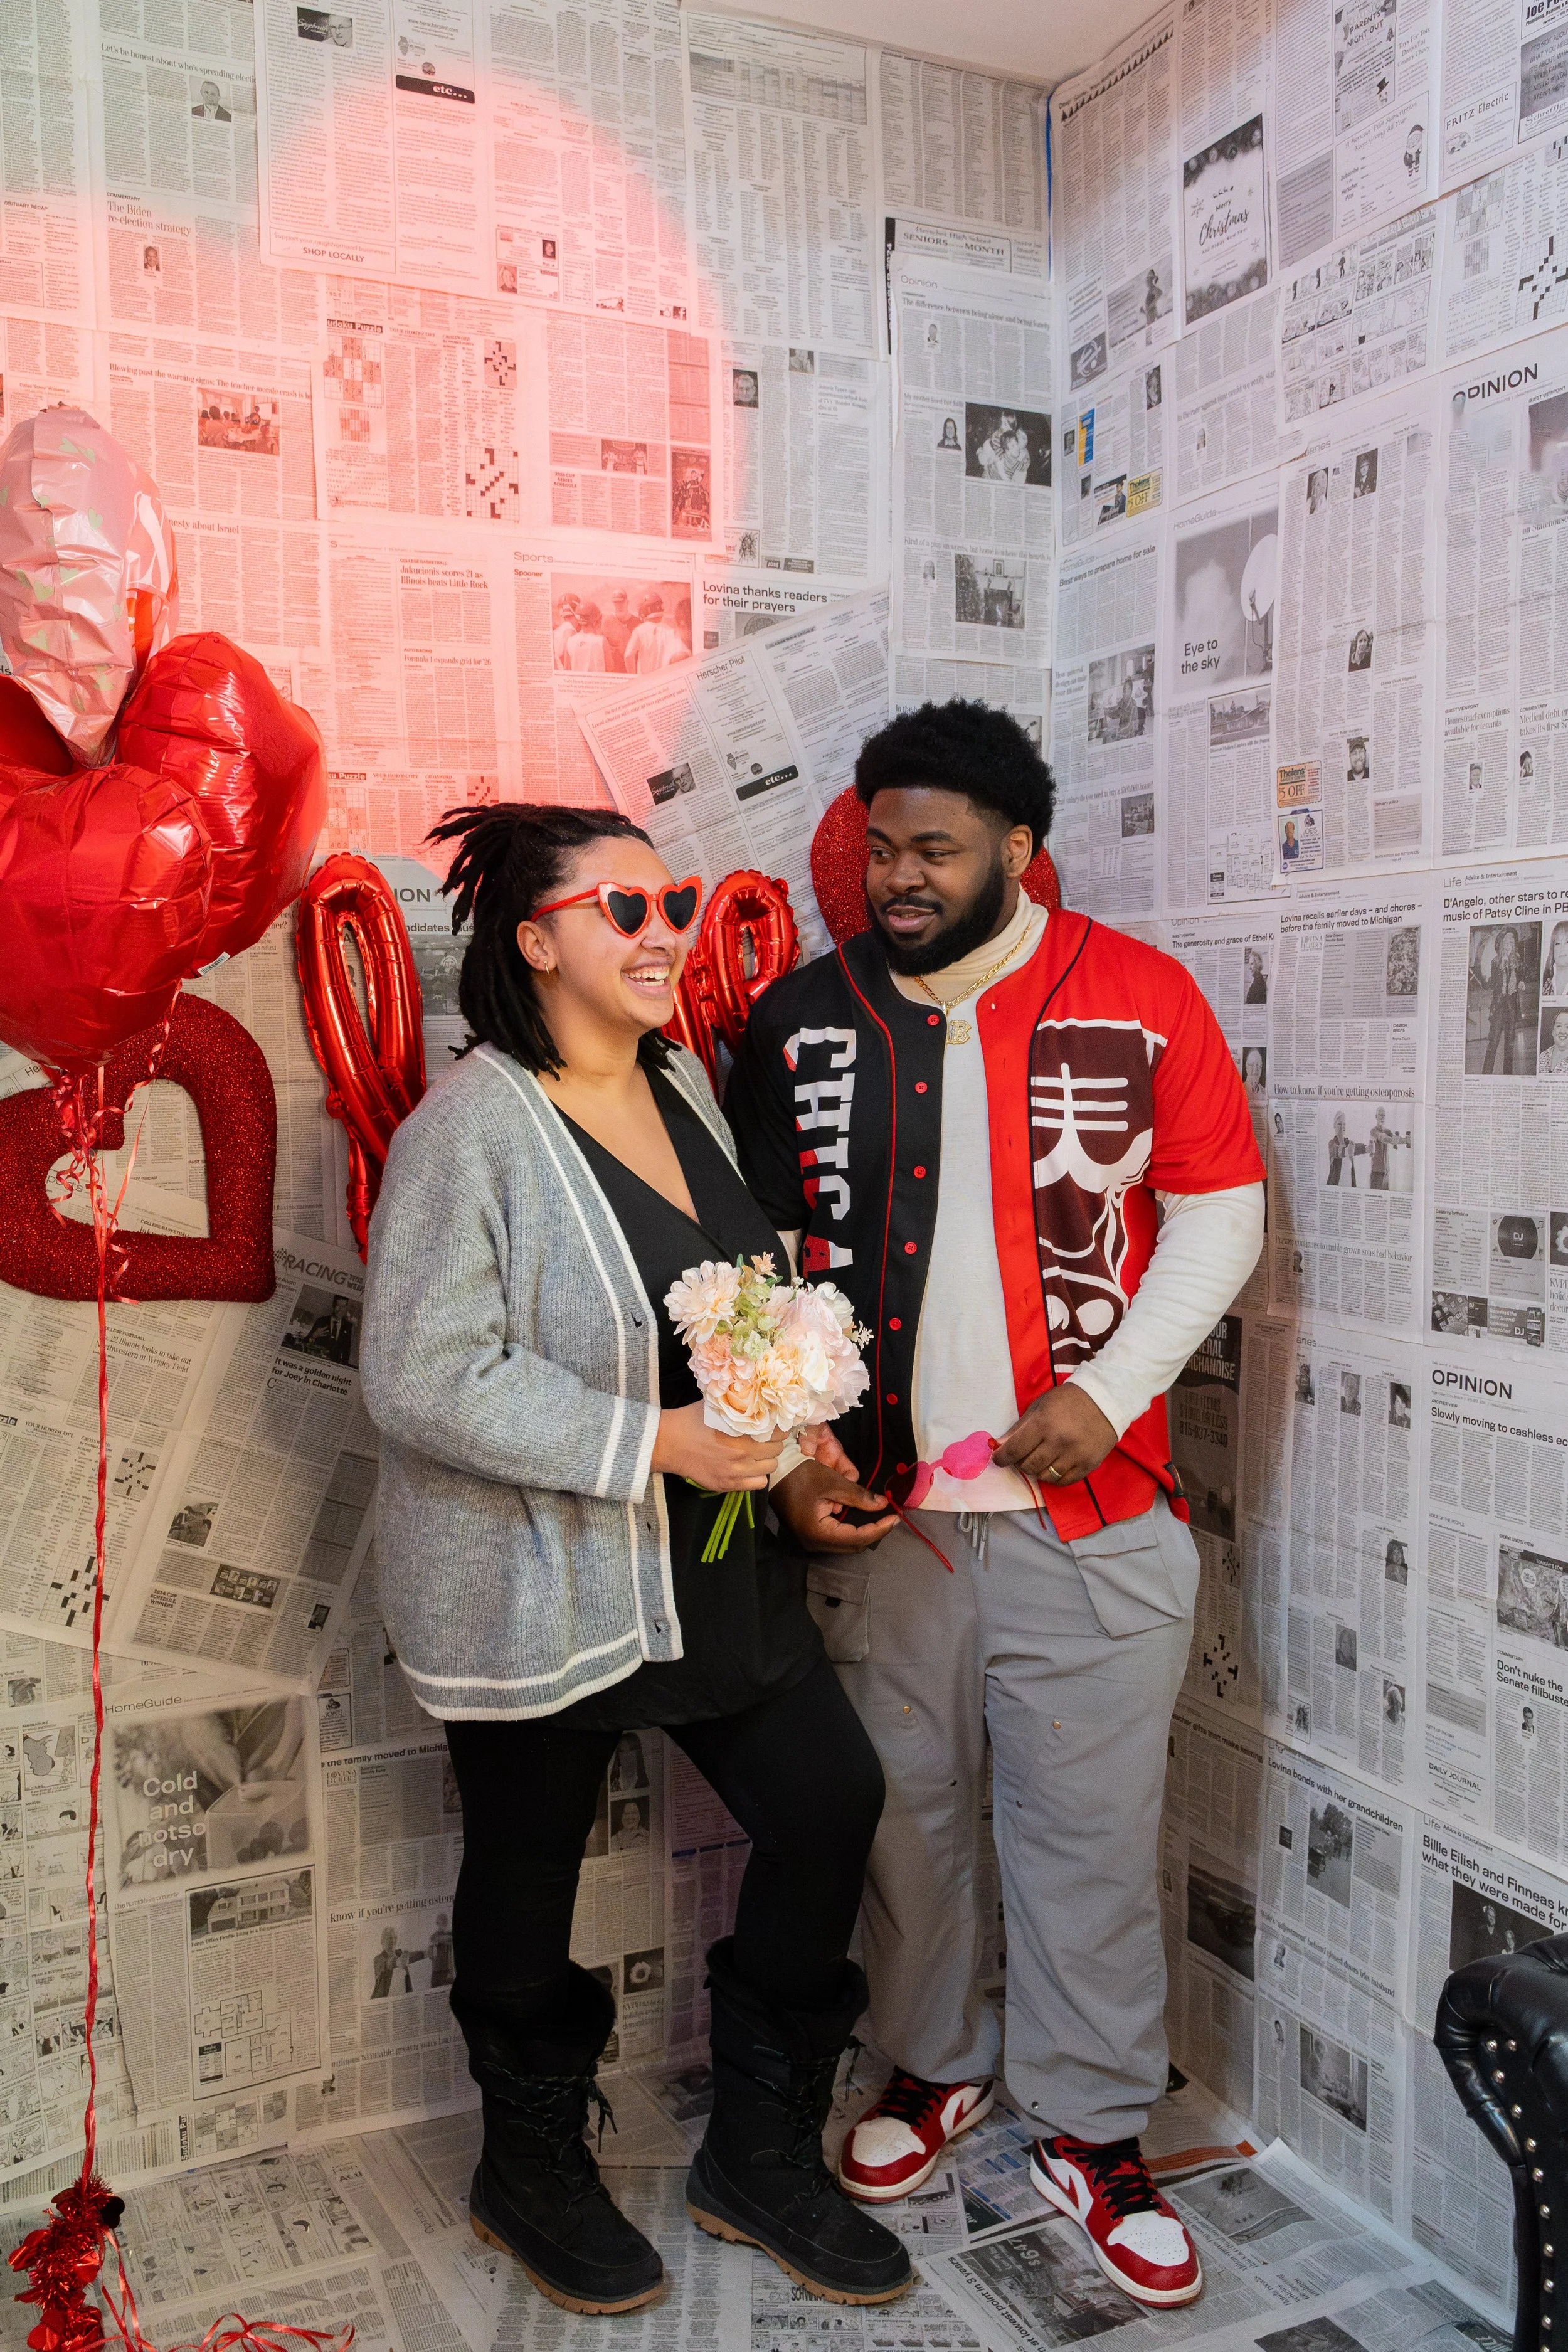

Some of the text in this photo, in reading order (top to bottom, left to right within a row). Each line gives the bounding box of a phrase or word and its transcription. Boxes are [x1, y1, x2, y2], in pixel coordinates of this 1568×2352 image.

[1526, 1, 1544, 19] Joe
[1350, 9, 1381, 35] PARENTS
[1347, 19, 1384, 48] NIGHT OUT
[102, 43, 234, 80] Let's be honest about who's spreading
[433, 85, 467, 99] etc...
[1446, 93, 1509, 130] FRITZ Electric
[107, 201, 152, 218] The Biden
[108, 214, 191, 237] re-election strategy
[1199, 208, 1249, 246] Christmas
[303, 246, 365, 262] SHOP LOCALLY
[903, 233, 1004, 256] SENIORS MONTH
[110, 363, 255, 392] Blowing past the warning The teacher
[1173, 509, 1217, 531] HomeGuide
[514, 551, 554, 563] Sports
[401, 576, 489, 590] Illinois beats Little Rock
[442, 569, 465, 578] scores
[514, 569, 543, 578] Spooner
[703, 581, 827, 603] Lovina thanks readers
[703, 594, 796, 613] for their prayers
[1184, 638, 1218, 657] Eye to
[696, 655, 746, 681] Herscher Pilot
[1181, 654, 1221, 675] the sky
[1444, 707, 1510, 726] Homestead exemptions
[1520, 708, 1560, 724] Medical debt
[1444, 719, 1502, 737] available for tenants
[1520, 721, 1560, 737] takes its first
[765, 771, 792, 786] etc...
[1279, 766, 1306, 778] Tholens'
[1443, 877, 1462, 889] Life
[1486, 871, 1517, 879] Entertainment
[1444, 890, 1557, 909] D'Angelo, other stars to
[1281, 903, 1416, 924] Lovina recalls earlier days and chores
[1443, 904, 1551, 923] music of Patsy Cline in
[1280, 915, 1402, 934] before the family moved to Michigan
[1173, 933, 1268, 950] The generosity and grace of Ethel
[1274, 1084, 1415, 1100] How to know if you're getting osteoporosis
[783, 1026, 857, 1279] CHICA
[1513, 1232, 1523, 1240] DJ
[284, 1254, 347, 1285] RACING
[1515, 1327, 1525, 1336] DJ
[275, 1357, 282, 1365] It
[283, 1360, 297, 1370] was
[305, 1365, 331, 1380] golden
[332, 1373, 352, 1387] night
[1184, 1355, 1236, 1381] RCHANDISE
[272, 1366, 348, 1396] for Joey in Charlotte
[1432, 1369, 1512, 1399] OPINION
[1431, 1406, 1554, 1444] Slowly moving to cashless
[1496, 1660, 1564, 1693] Don't nuke the
[1496, 1671, 1529, 1692] Senate
[105, 1696, 182, 1715] HomeGuide
[142, 1770, 198, 1798] Cold
[1429, 1762, 1481, 1791] DAILY JOURNAL
[1268, 1757, 1404, 1833] Lovina bonds with her grandchildren
[149, 1795, 194, 1821] and
[153, 1847, 194, 1868] dry
[1423, 1834, 1555, 1910] Billie Eilish and Finneas
[1422, 1851, 1567, 1931] what they were made for
[330, 1897, 428, 1923] know if you're getting
[180, 2131, 188, 2161] Sudoku
